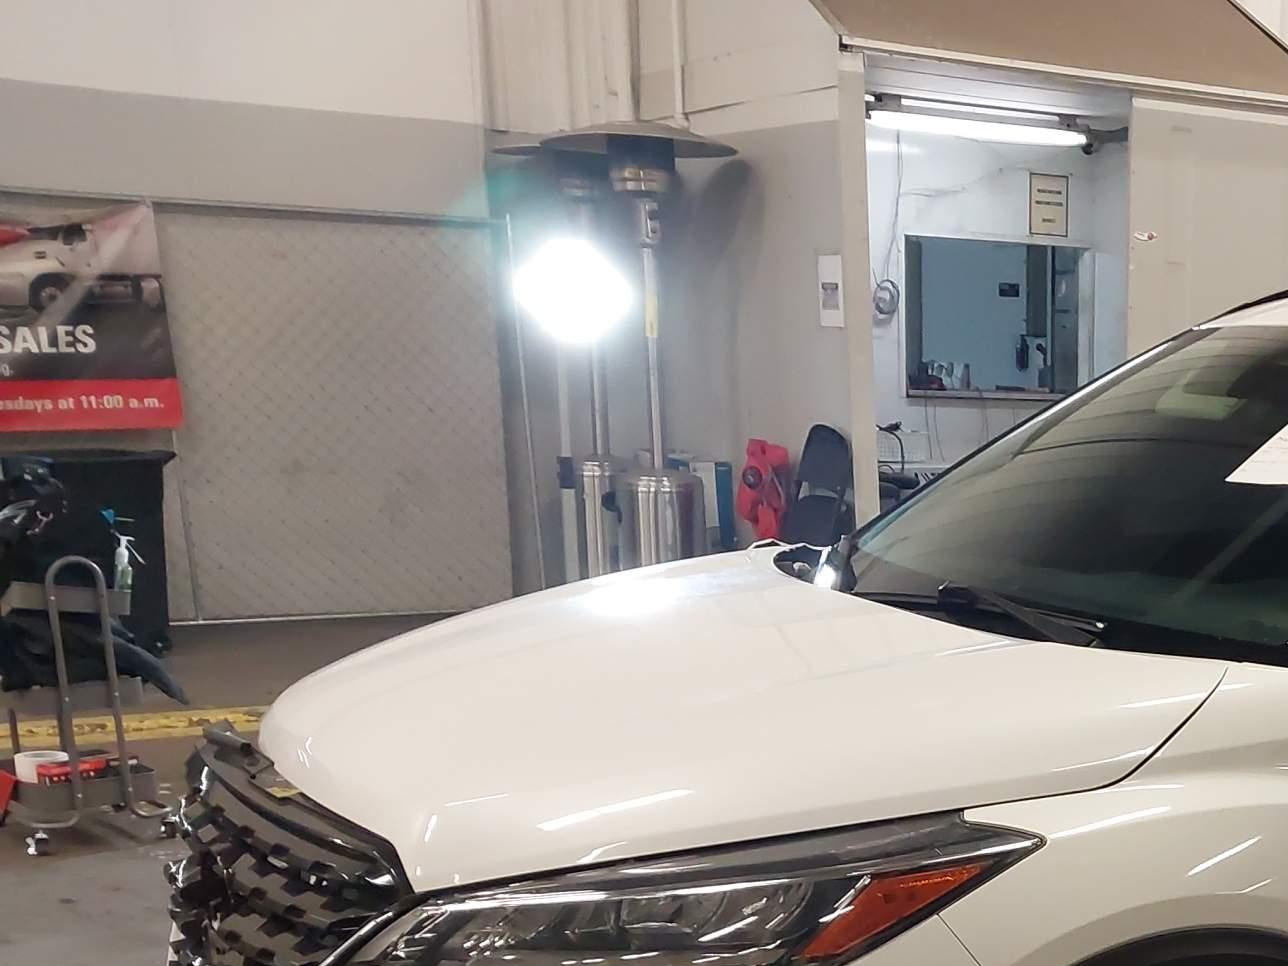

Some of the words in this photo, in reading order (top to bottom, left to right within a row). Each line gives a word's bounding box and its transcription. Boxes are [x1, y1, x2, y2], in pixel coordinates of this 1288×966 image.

[0, 324, 97, 354] SALES
[58, 397, 75, 410] at
[80, 395, 123, 409] 11:00
[129, 397, 165, 409] a.m.
